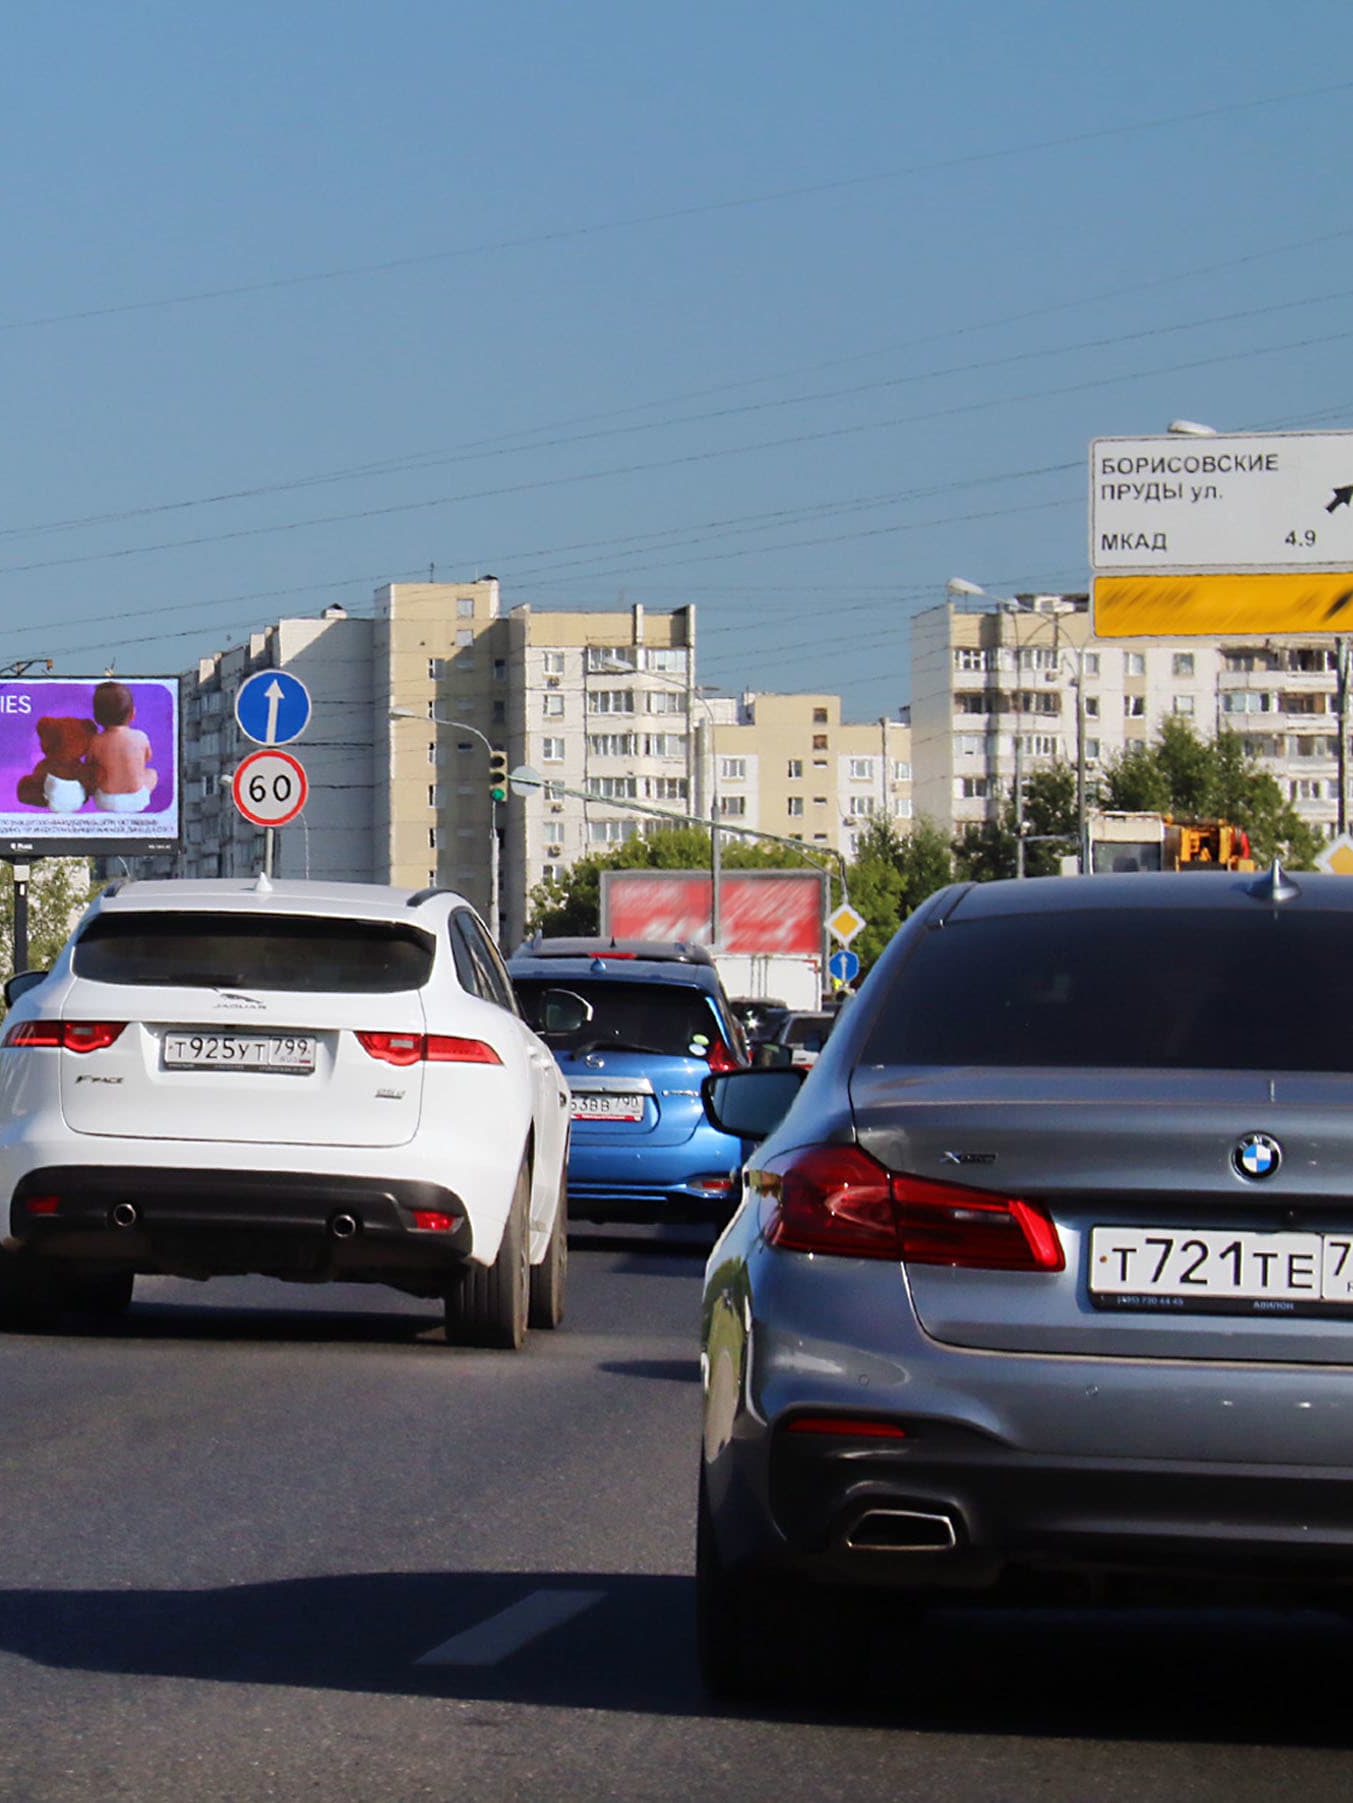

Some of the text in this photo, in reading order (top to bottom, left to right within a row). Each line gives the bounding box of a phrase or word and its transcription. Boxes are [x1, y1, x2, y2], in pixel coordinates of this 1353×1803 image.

[1101, 454, 1279, 475] БОРИСОВСКИЕ
[1101, 483, 1223, 502] ПРУДЫ ул.
[1101, 530, 1316, 551] МКАД 4.9
[249, 775, 291, 802] 60
[272, 1037, 309, 1056] 799
